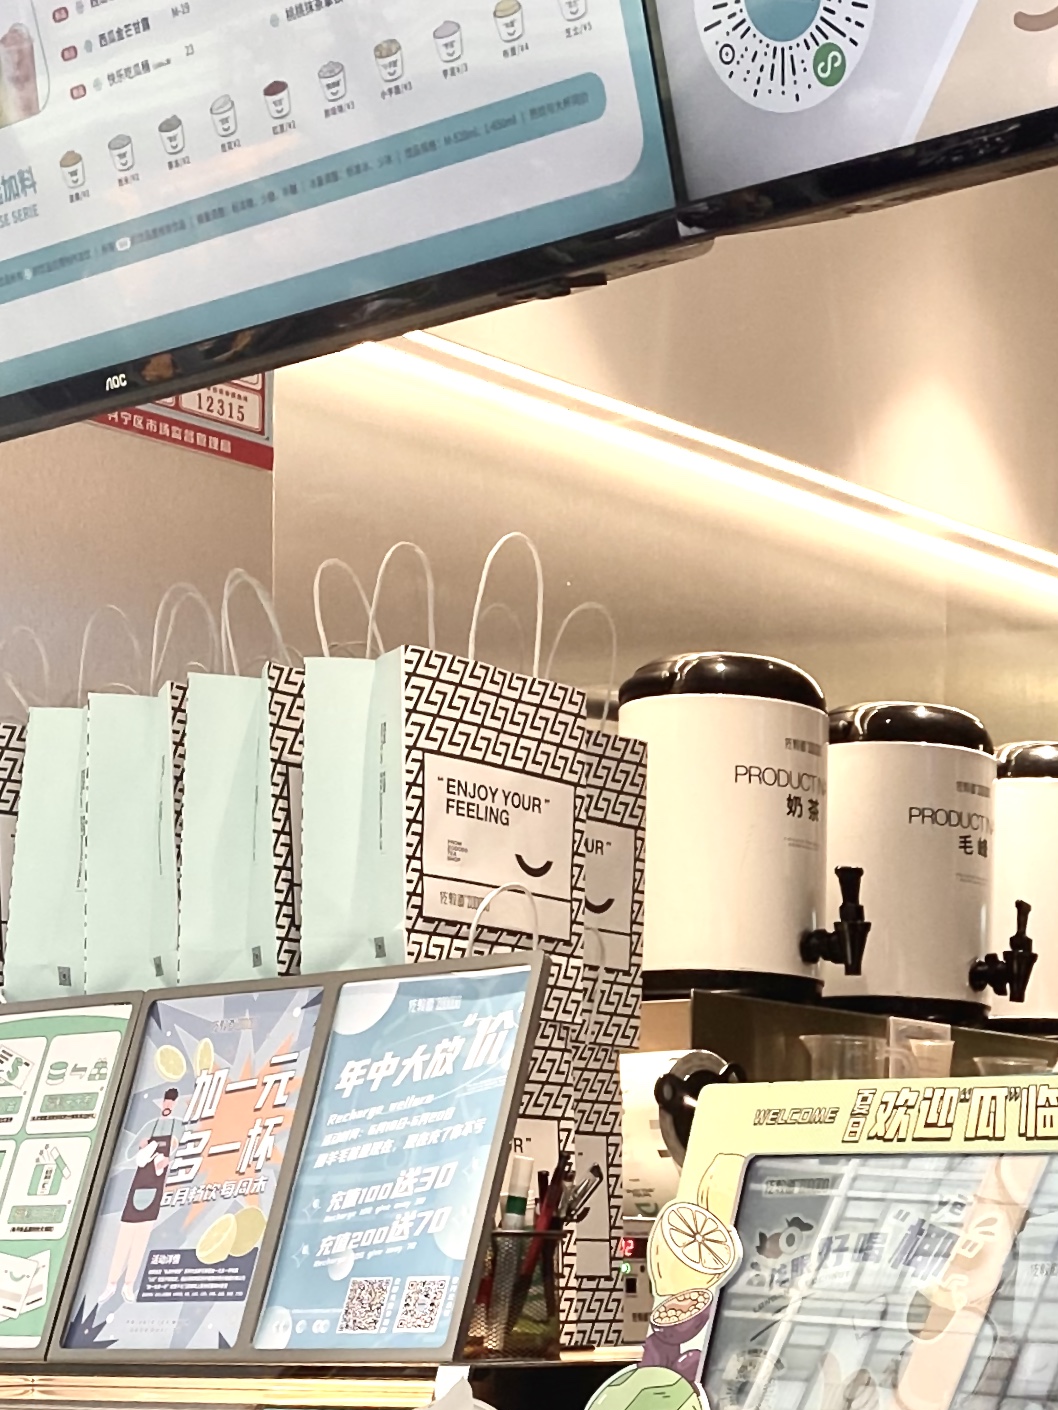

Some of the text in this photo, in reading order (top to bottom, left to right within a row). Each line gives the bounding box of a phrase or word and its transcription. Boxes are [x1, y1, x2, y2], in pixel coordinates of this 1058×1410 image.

[0, 166, 37, 204] 加料
[106, 374, 127, 391] AOC
[197, 393, 245, 422] 12315
[446, 798, 510, 826] FEELING
[786, 794, 819, 822] 奶茶
[182, 1052, 300, 1124] 加一元
[753, 1107, 840, 1126] WELCOME
[165, 1115, 284, 1187] 多一杯
[325, 1161, 459, 1213] 充值100送30
[315, 1206, 452, 1257] 充值200送70
